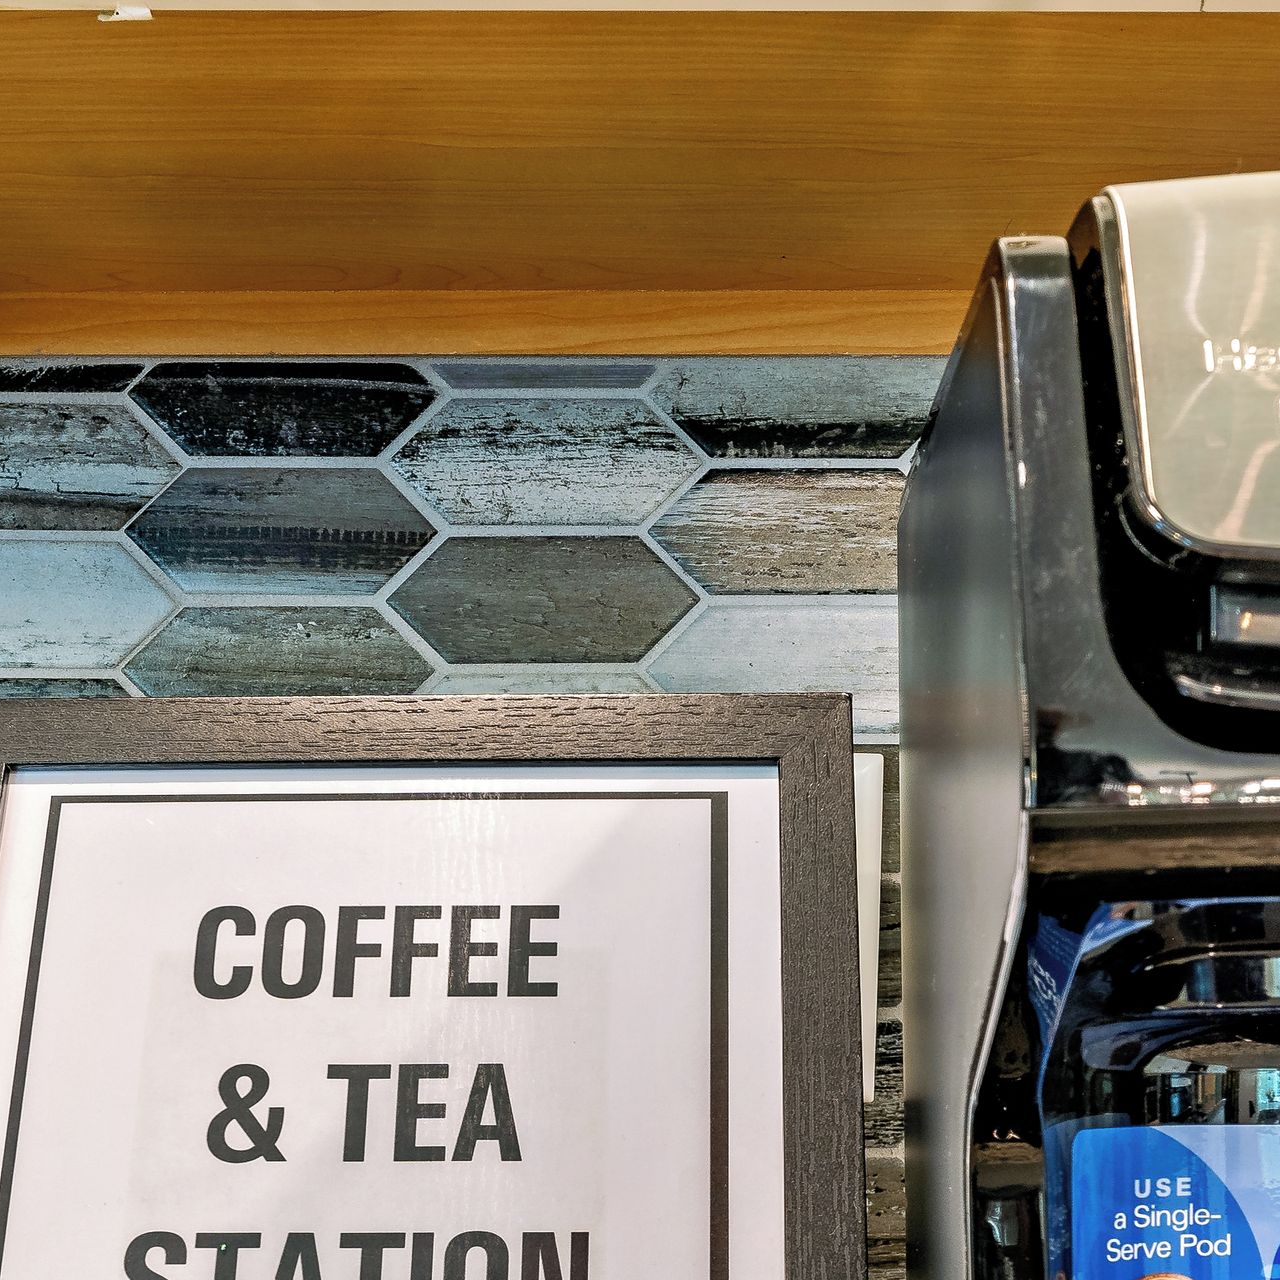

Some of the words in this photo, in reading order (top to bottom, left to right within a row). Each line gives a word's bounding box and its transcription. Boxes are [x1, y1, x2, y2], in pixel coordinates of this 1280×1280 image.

[193, 905, 560, 999] COFFEE
[207, 1063, 287, 1163] &
[327, 1063, 522, 1161] TEA
[1134, 1177, 1192, 1198] USE
[1113, 1212, 1127, 1229] a
[1134, 1203, 1221, 1231] Single-
[1107, 1239, 1171, 1262] Serve
[1180, 1233, 1231, 1257] Pod
